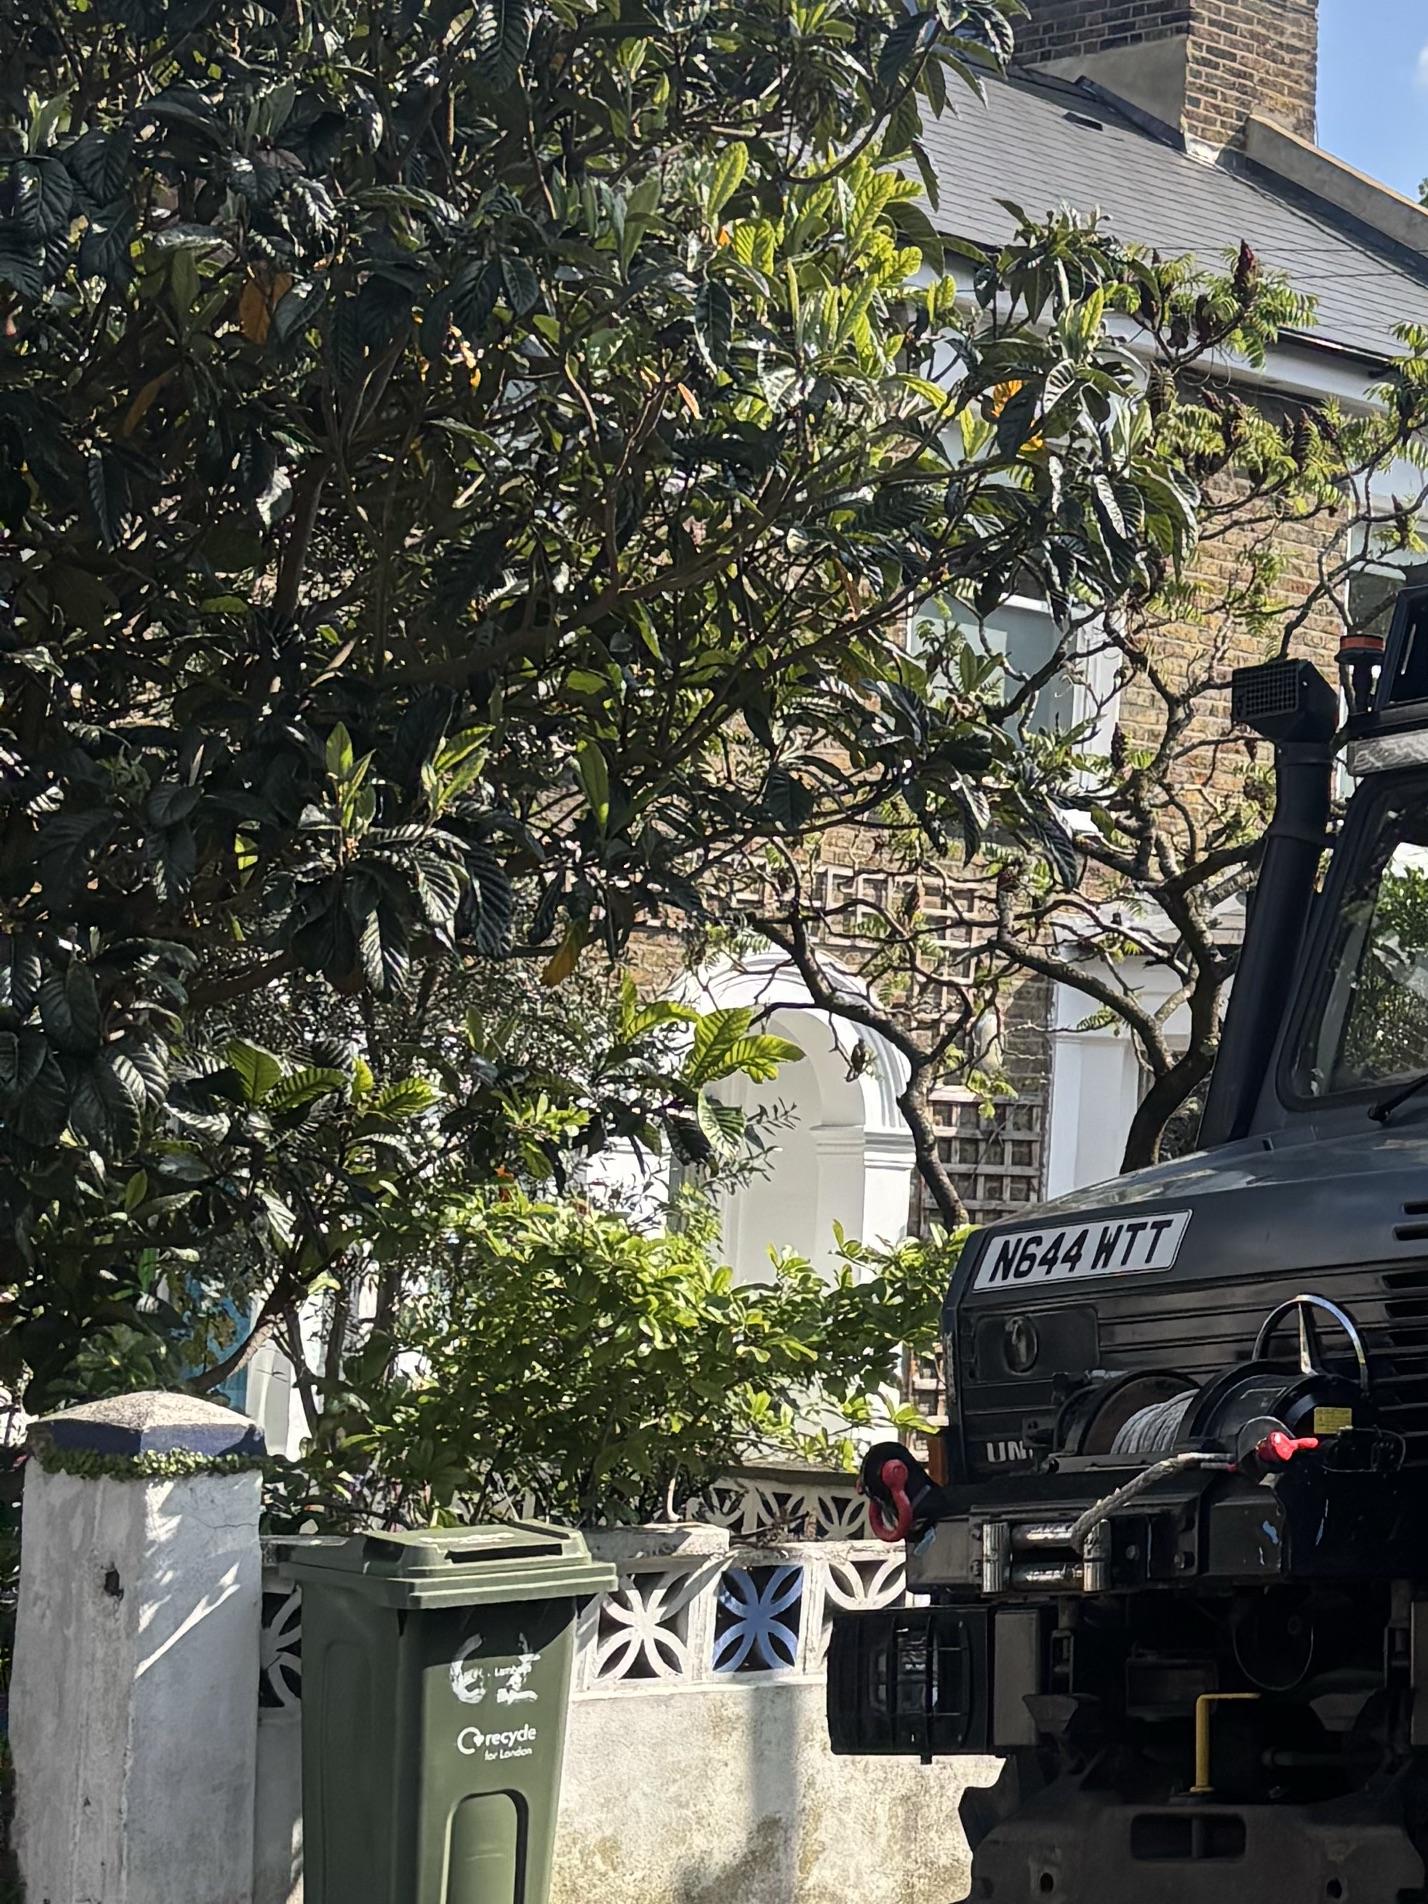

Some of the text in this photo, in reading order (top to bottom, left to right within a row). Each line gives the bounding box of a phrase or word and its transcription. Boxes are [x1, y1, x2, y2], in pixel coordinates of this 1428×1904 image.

[988, 1219, 1175, 1283] N644 WTT
[485, 1723, 537, 1747] recycle
[499, 1747, 533, 1760] London
